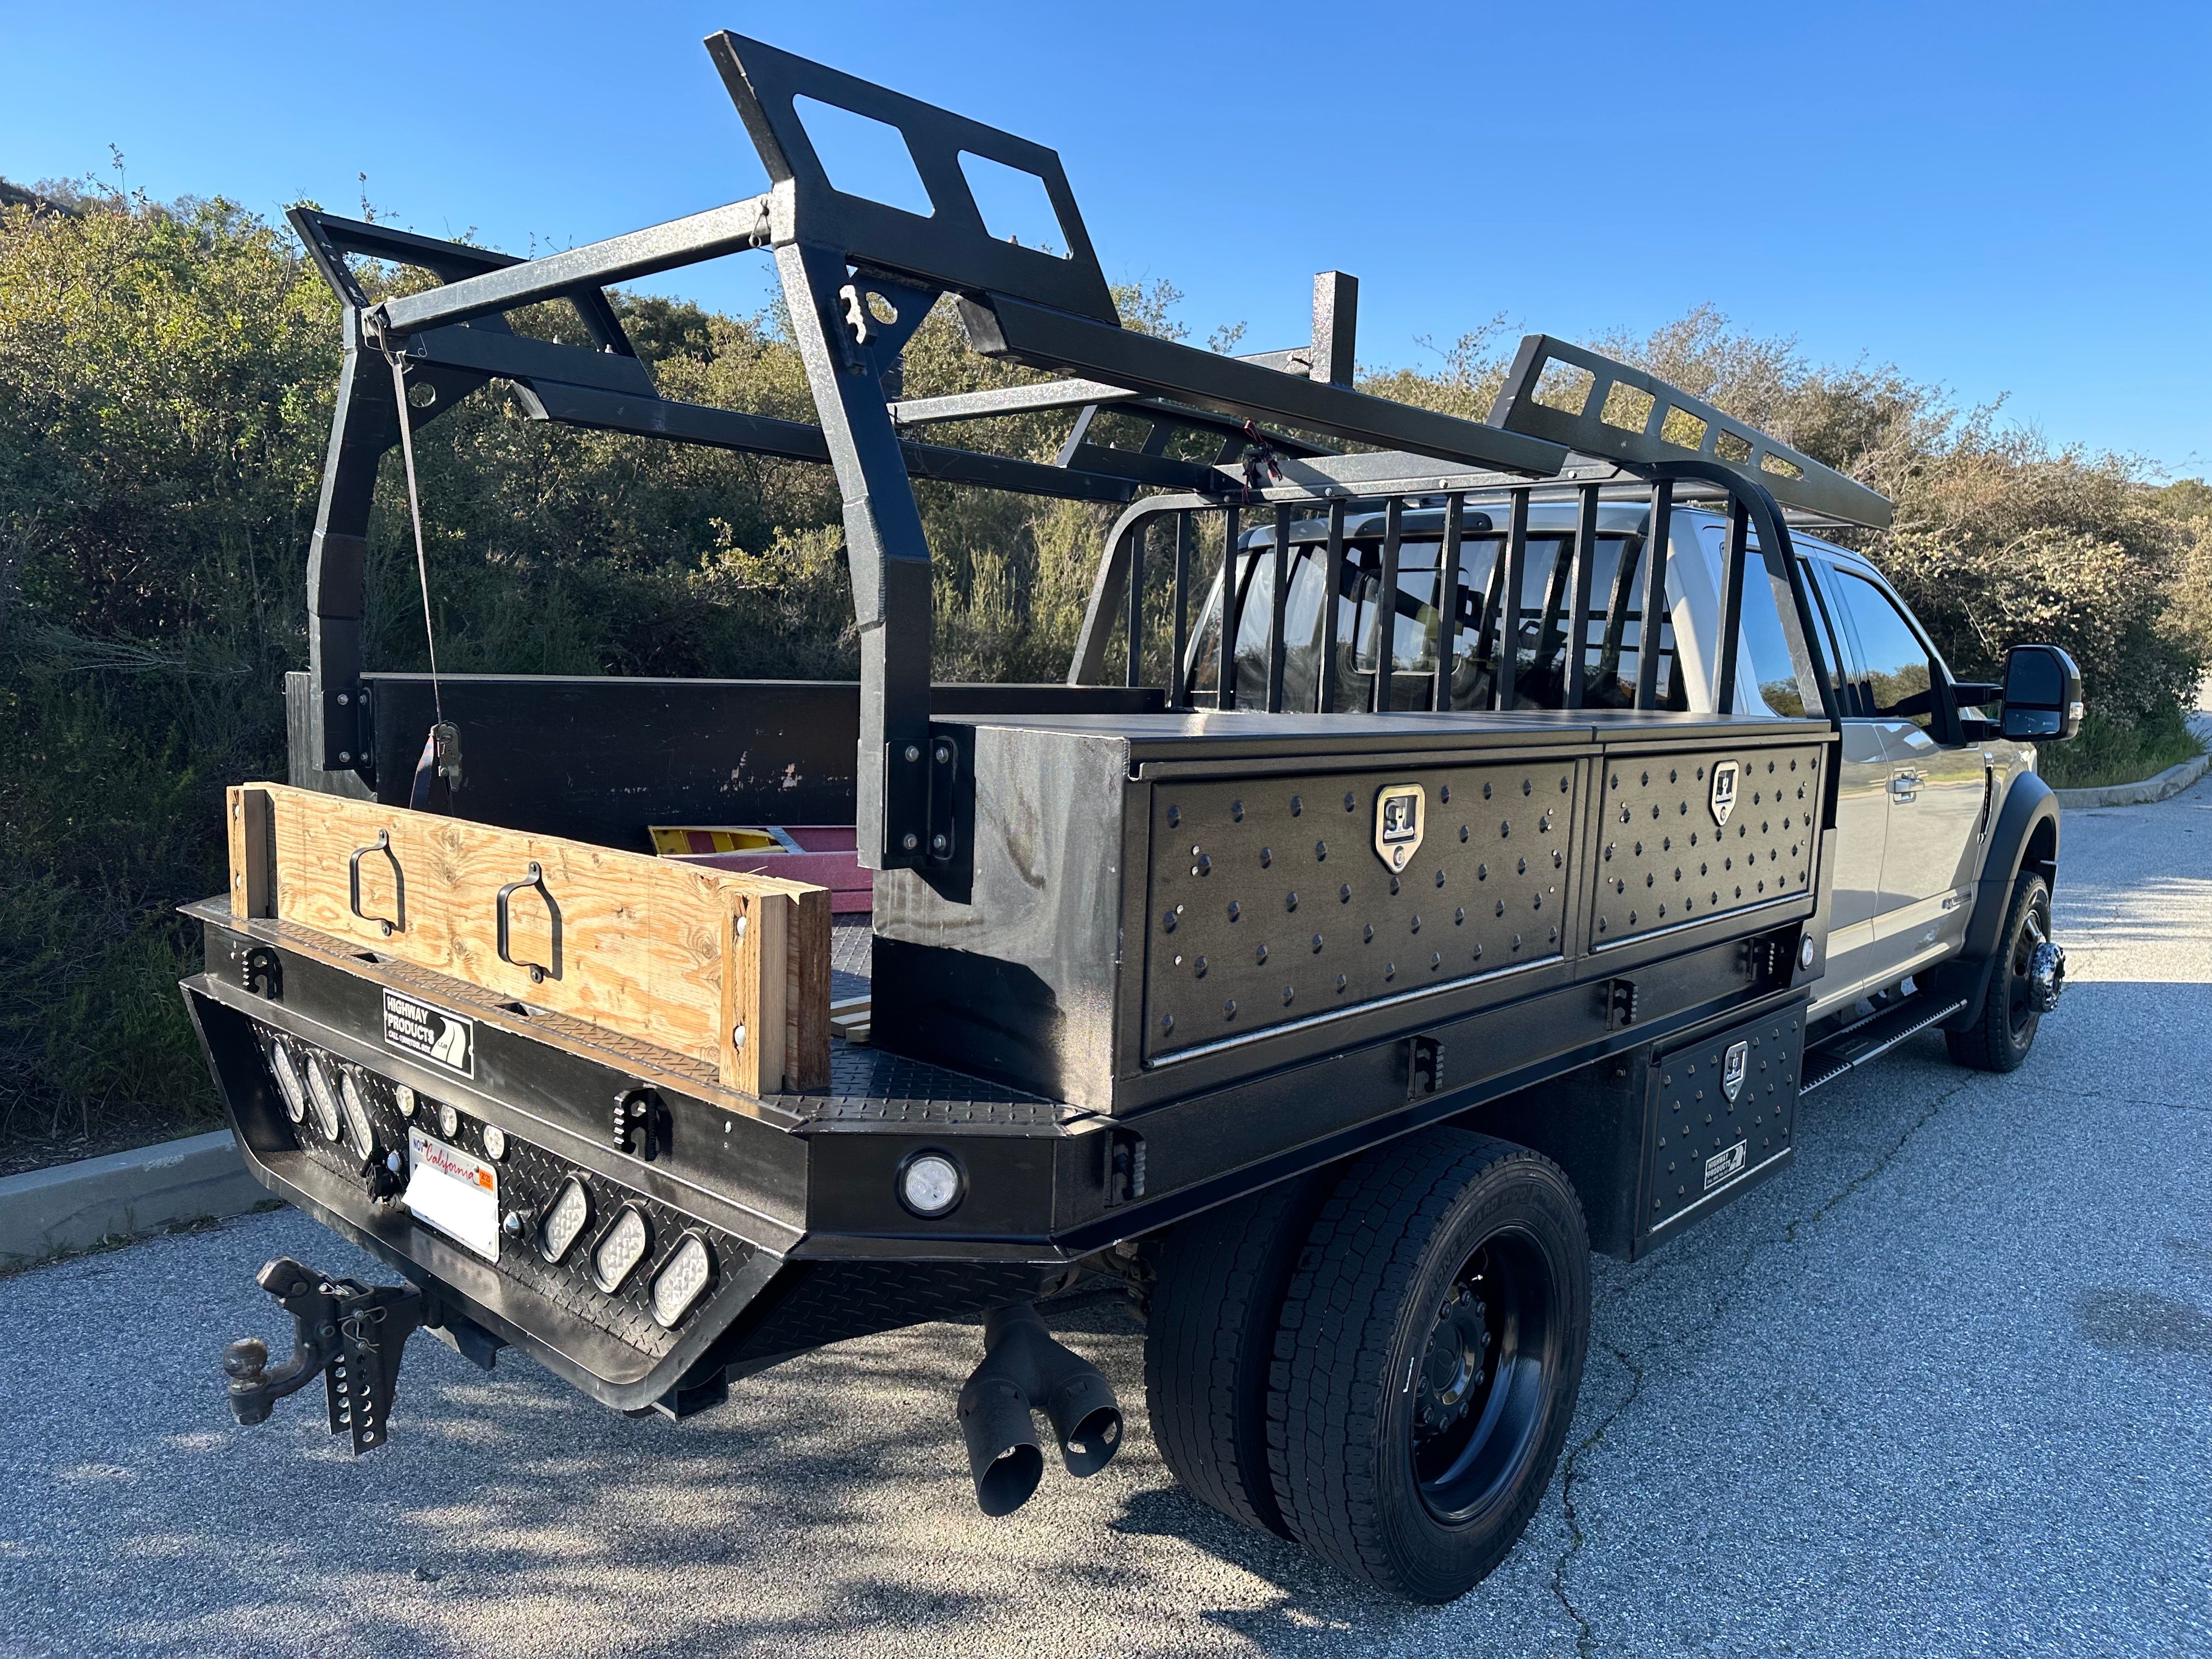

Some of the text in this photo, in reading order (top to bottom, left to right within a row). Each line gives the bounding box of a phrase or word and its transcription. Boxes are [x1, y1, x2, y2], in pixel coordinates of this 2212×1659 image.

[387, 996, 428, 1024] HIGHWAY
[388, 1013, 435, 1045] PRODUCTS
[413, 1137, 425, 1153] NOV
[426, 1143, 480, 1186] California
[1707, 1159, 1731, 1178] PRODUCTS
[1708, 1152, 1729, 1170] HIGHWAY
[1462, 1198, 1498, 1240] GUARD
